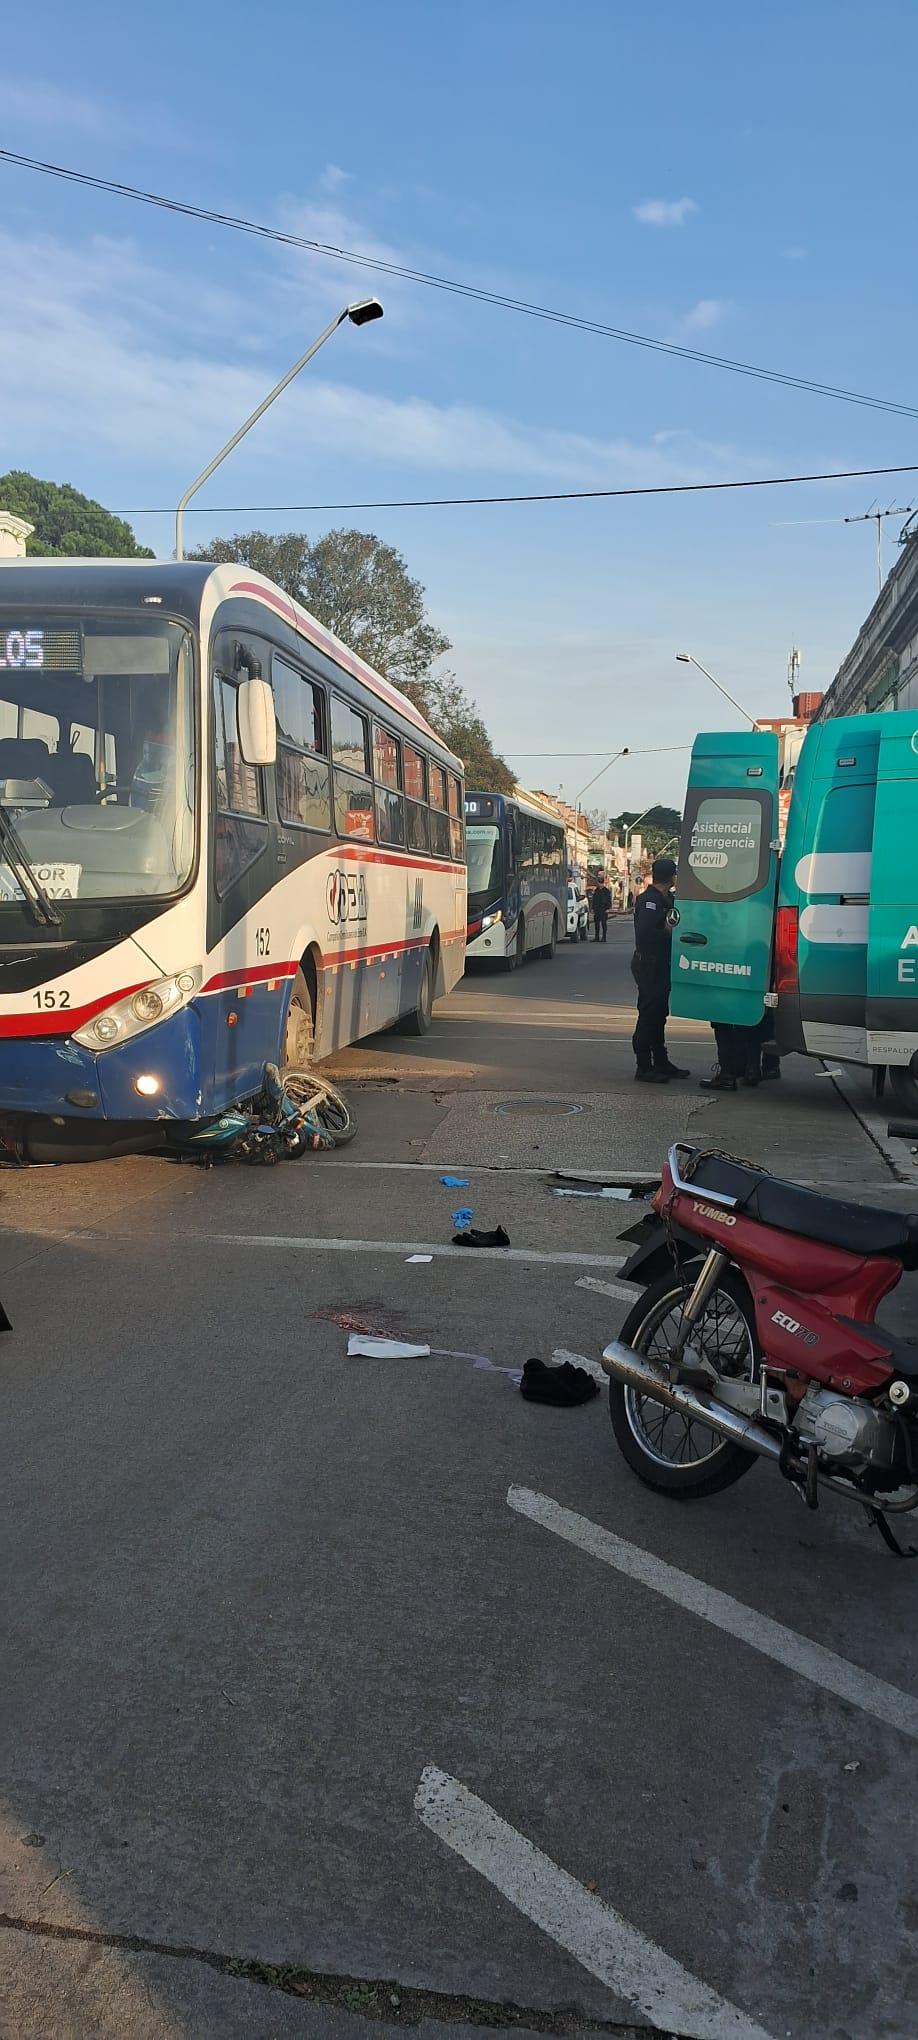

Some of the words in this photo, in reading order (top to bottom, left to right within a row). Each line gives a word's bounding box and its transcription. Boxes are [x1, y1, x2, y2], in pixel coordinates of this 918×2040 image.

[692, 822, 752, 834] Asistencial
[690, 836, 755, 849] Emergencia
[693, 853, 722, 865] Móvil
[14, 887, 73, 899] PAYA
[256, 927, 271, 956] 152
[691, 960, 752, 976] FEPREMI
[33, 991, 71, 1008] 152
[693, 1201, 737, 1226] YUMBO
